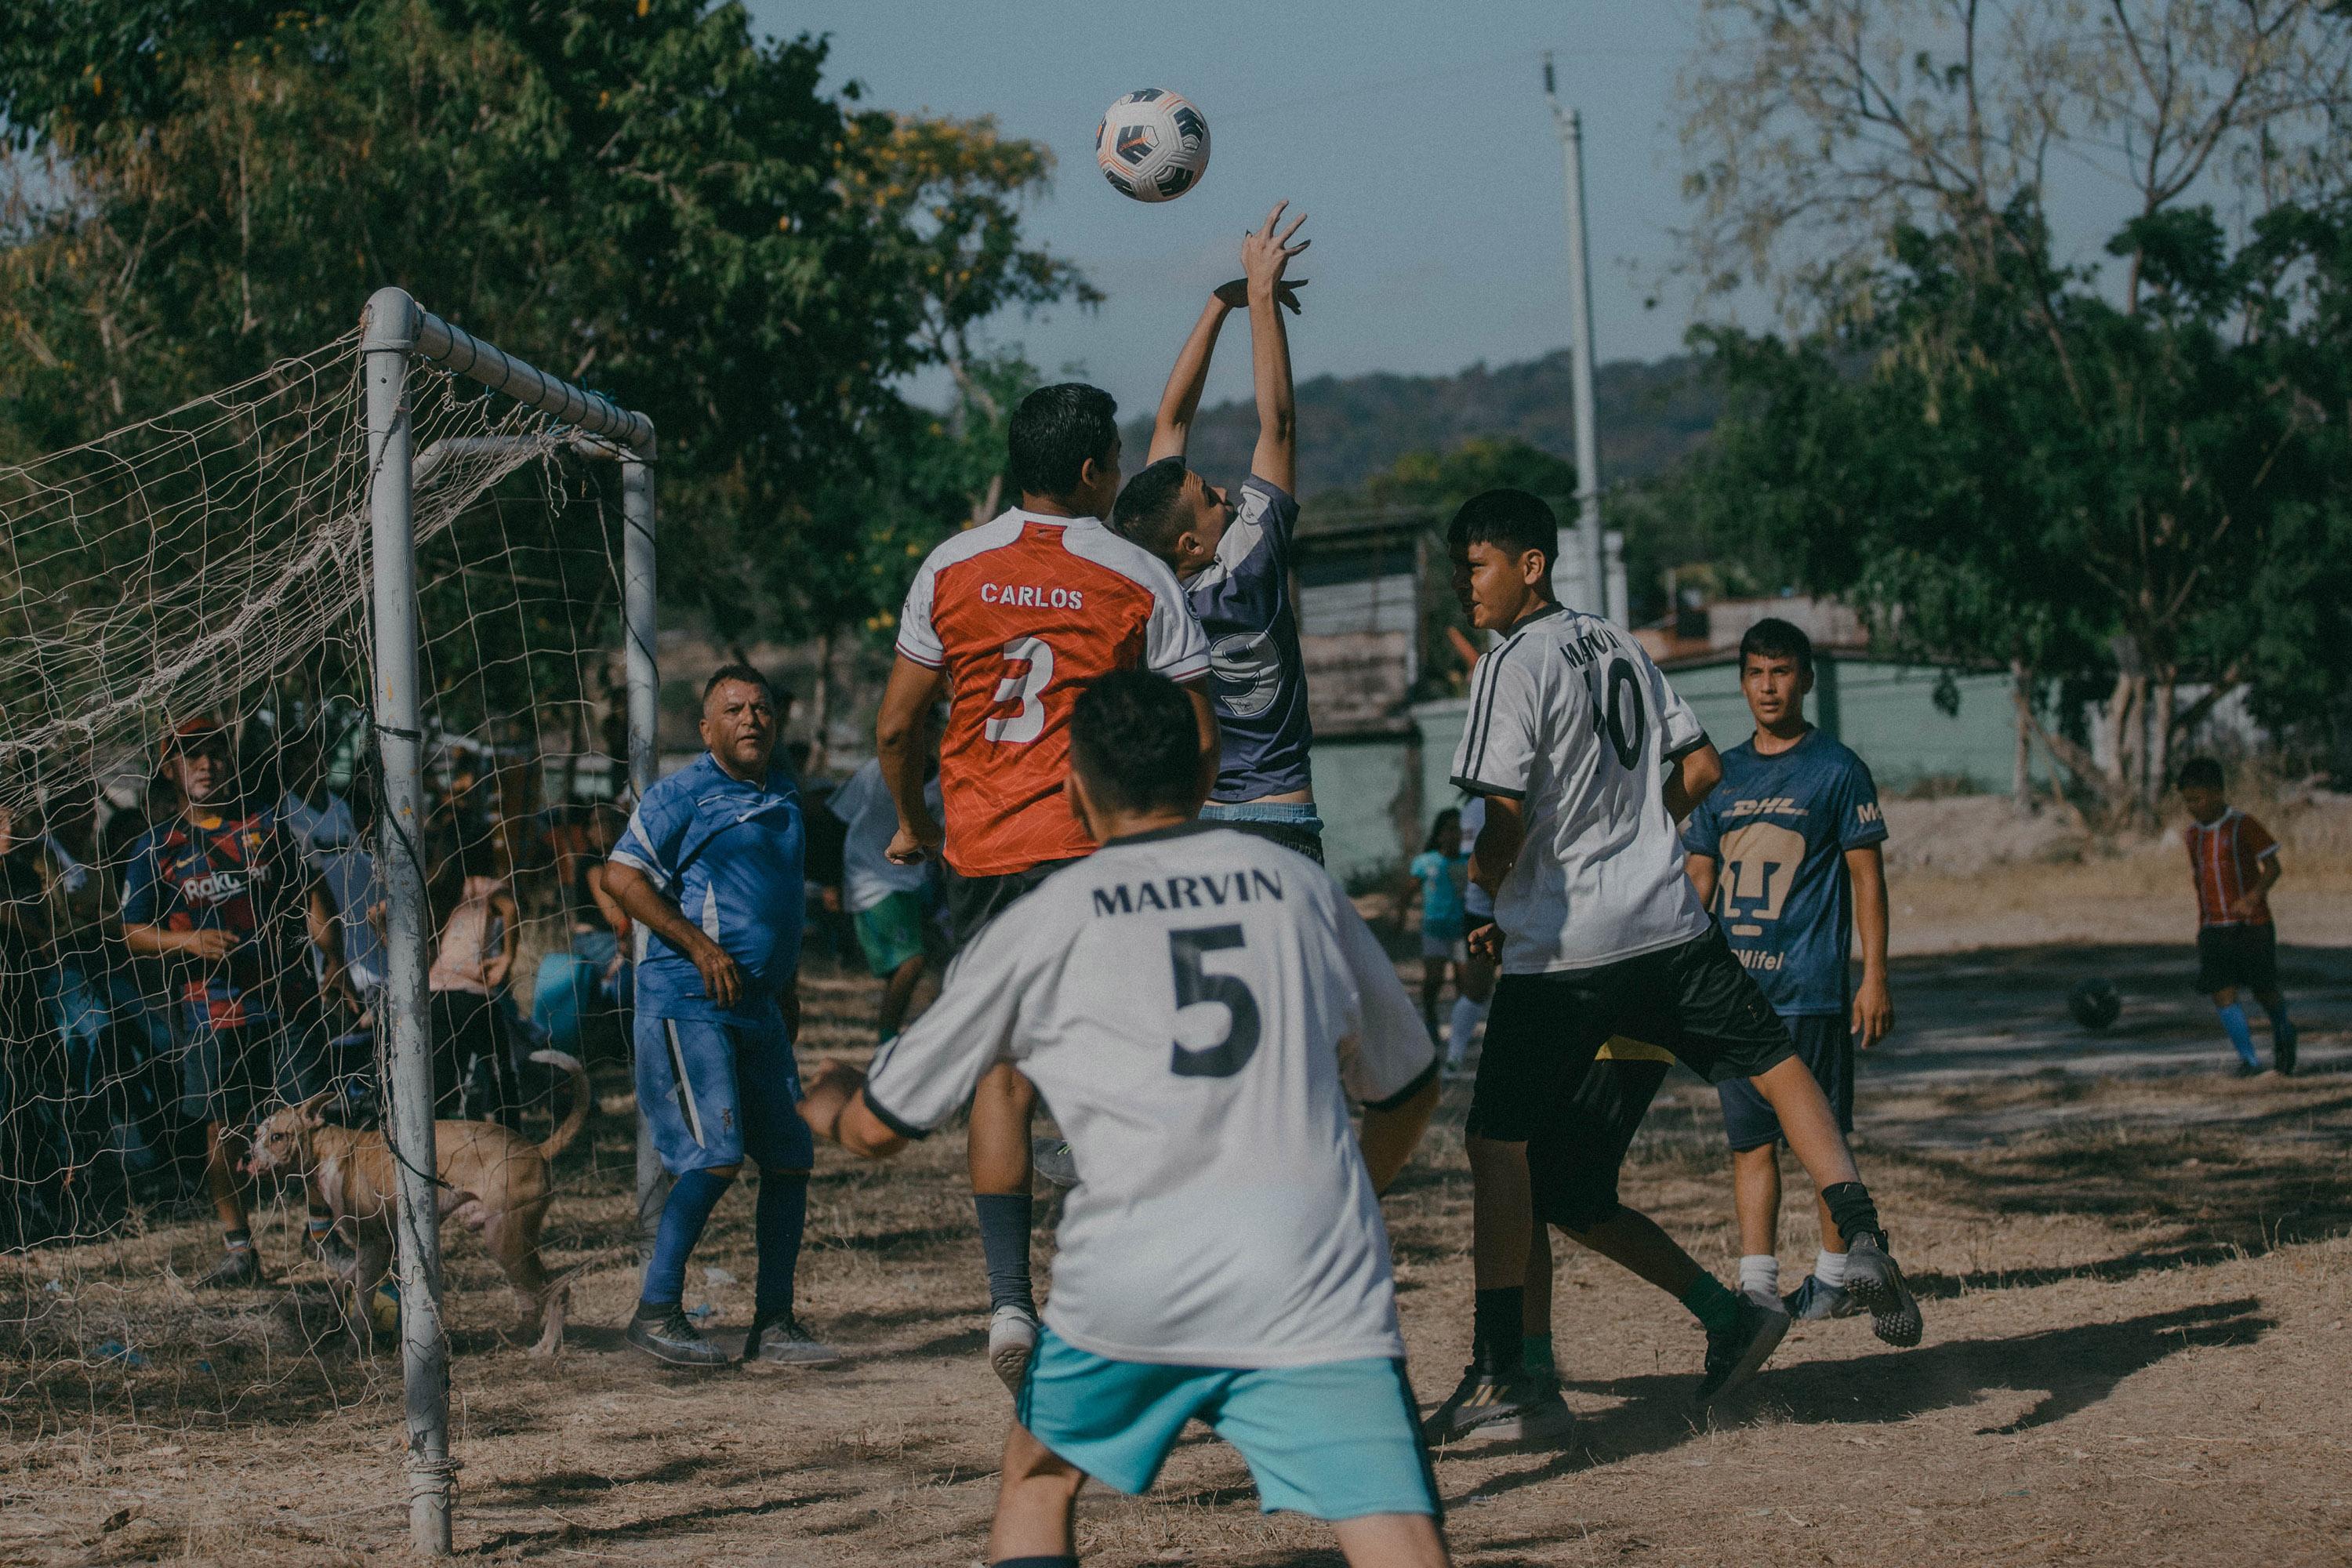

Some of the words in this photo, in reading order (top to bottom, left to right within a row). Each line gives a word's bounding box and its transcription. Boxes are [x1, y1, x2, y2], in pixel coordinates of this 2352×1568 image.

[981, 583, 1083, 609] CARLOS
[985, 637, 1054, 743] 3
[1210, 632, 1283, 717] 9
[1730, 797, 1798, 816] DHL
[1093, 868, 1285, 916] MARVIN
[1169, 924, 1261, 1077] 5
